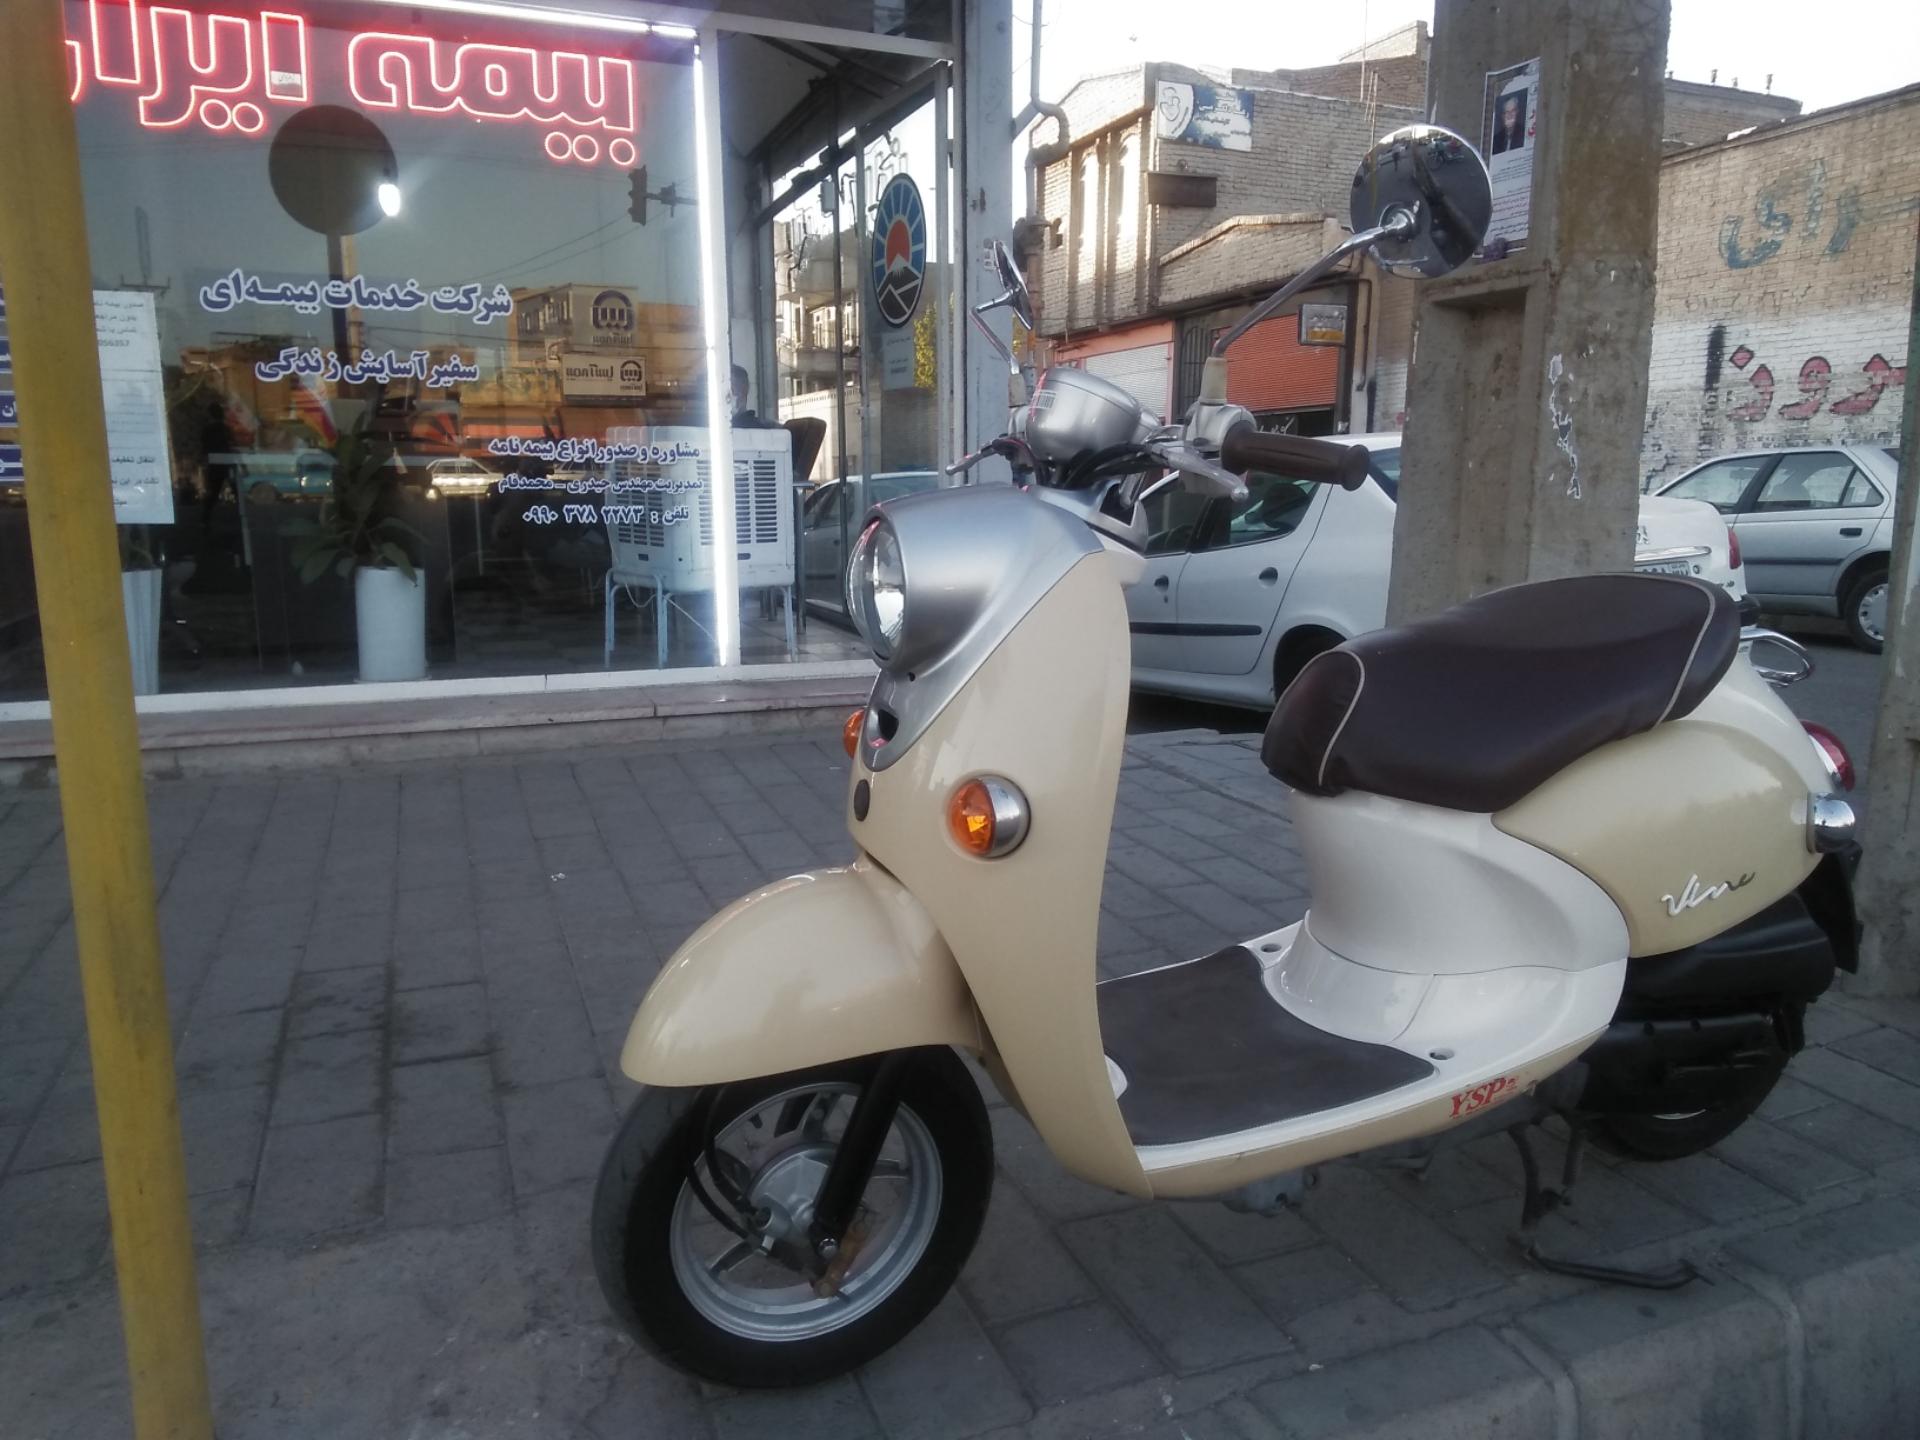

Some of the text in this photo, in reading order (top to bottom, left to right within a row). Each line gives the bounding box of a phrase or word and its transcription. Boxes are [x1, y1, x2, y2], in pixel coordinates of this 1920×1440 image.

[64, 0, 637, 166] بیمه ایرا
[322, 274, 429, 311] خدمات
[431, 283, 514, 324] شرکت
[255, 346, 479, 388] سفیر آسایش زندگی
[488, 436, 701, 465] مشاوره و صدور انواع بیمه نامه
[566, 475, 611, 494] حیدری
[612, 476, 653, 494] مهندس
[522, 504, 558, 524] ۰۹۹۰
[563, 504, 599, 524] ۳۷۸
[601, 504, 643, 524] ۲۲۷۳
[662, 504, 690, 524] تلفن
